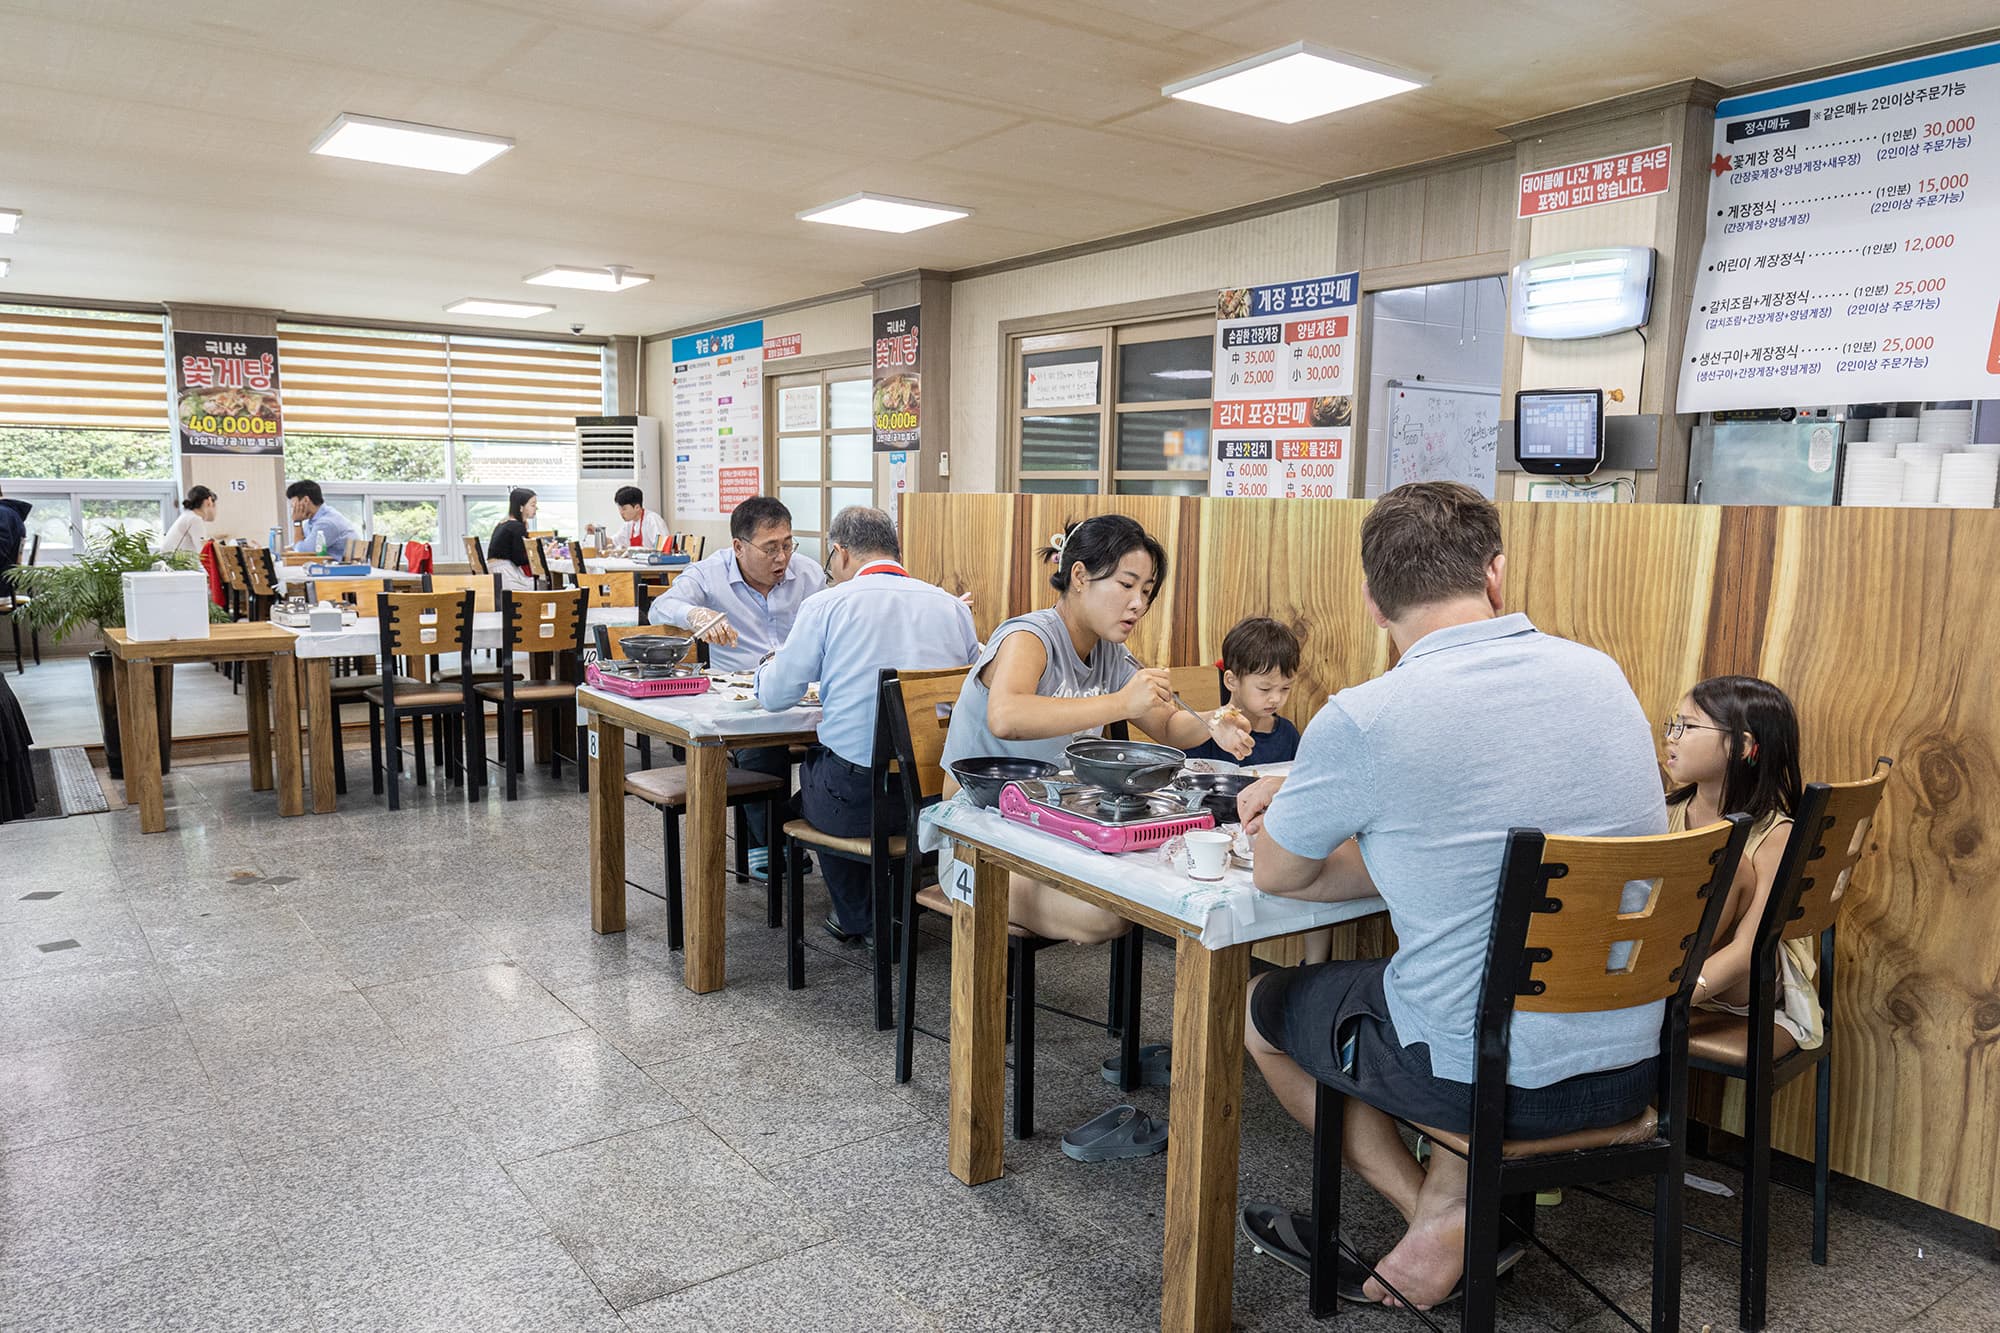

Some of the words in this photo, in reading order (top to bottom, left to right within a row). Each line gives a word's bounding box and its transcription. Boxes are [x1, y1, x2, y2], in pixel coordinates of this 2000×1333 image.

[1744, 116, 1791, 135] 정식메뉴
[1732, 151, 1770, 171] 꽃게장
[1772, 145, 1797, 165] 정식
[1881, 126, 1917, 145] (1인분)
[1923, 115, 1976, 138] 30,000
[1729, 152, 1861, 186] (간장꽃게장+양념게장+새우장)
[1876, 143, 1921, 162] (2인이상
[1924, 134, 1972, 155] 주문가능)
[1522, 171, 1564, 194] 테이블에
[1566, 167, 1590, 187] 나간
[1591, 161, 1616, 180] 게장
[1617, 160, 1630, 177] 및
[1631, 150, 1668, 174] 음식은
[1537, 190, 1569, 212] 포장이
[1571, 185, 1595, 206] 되지
[1596, 177, 1647, 201] 않습니다.
[1727, 200, 1777, 219] 게장정식
[1876, 182, 1911, 199] (1인분)
[1918, 172, 1969, 194] 15,000
[1723, 212, 1810, 234] (간장게장+양념게장)
[1870, 197, 1914, 215] (2인이상
[1915, 190, 1965, 210] 주문가능)
[1716, 257, 1751, 274] 어린이
[1753, 250, 1805, 270] 게장정식
[1862, 240, 1897, 256] (1인분)
[1903, 234, 1955, 252] 12,000
[1258, 287, 1286, 313] 게장
[1290, 277, 1352, 309] 포장판매
[1710, 290, 1810, 314] 갈치조림+게장정식
[1853, 284, 1889, 299] (1인분)
[1894, 277, 1946, 296] 25,000
[1705, 305, 1832, 331] (갈치조림+간장게장+양념게장)
[1847, 300, 1890, 317] (2인이상
[1892, 297, 1941, 313] 주문가능)
[1228, 329, 1250, 345] 손질한
[1250, 325, 1279, 342] 간장게장
[1297, 320, 1337, 340] 양념게장
[205, 340, 247, 355] 국내산
[876, 325, 918, 368] 꽃게탕
[1293, 346, 1303, 361] 中
[1306, 343, 1341, 361] 40,000
[1699, 344, 1798, 367] 생선구이+게장정식
[1842, 340, 1877, 354] (1인분)
[1882, 336, 1934, 352] 25,000
[1231, 352, 1240, 365] 中
[1244, 348, 1275, 366] 35,000
[182, 352, 275, 391] 꽃게탕
[1230, 372, 1240, 385] 小
[1243, 369, 1274, 386] 25,000
[1292, 368, 1302, 383] 小
[1306, 364, 1340, 382] 30,000
[1696, 361, 1821, 383] (생선구이+간장게장+양념게장)
[1836, 358, 1878, 373] (2인이상
[1881, 355, 1929, 370] 주문가능)
[876, 412, 917, 431] 40,000원
[1219, 402, 1244, 426] 김치
[1248, 401, 1307, 426] 포장판매
[188, 415, 277, 435] 40,000원
[1225, 441, 1268, 457] 돌산갓김치
[1282, 440, 1338, 457] 돌산갓물김치
[1239, 463, 1268, 477] 60,000
[1300, 463, 1335, 478] 60,000
[231, 480, 246, 491] 15
[1238, 483, 1268, 497] 36,000
[1300, 484, 1333, 499] 36,000
[584, 650, 597, 663] 10
[590, 734, 596, 756] 8
[956, 868, 972, 901] 4
